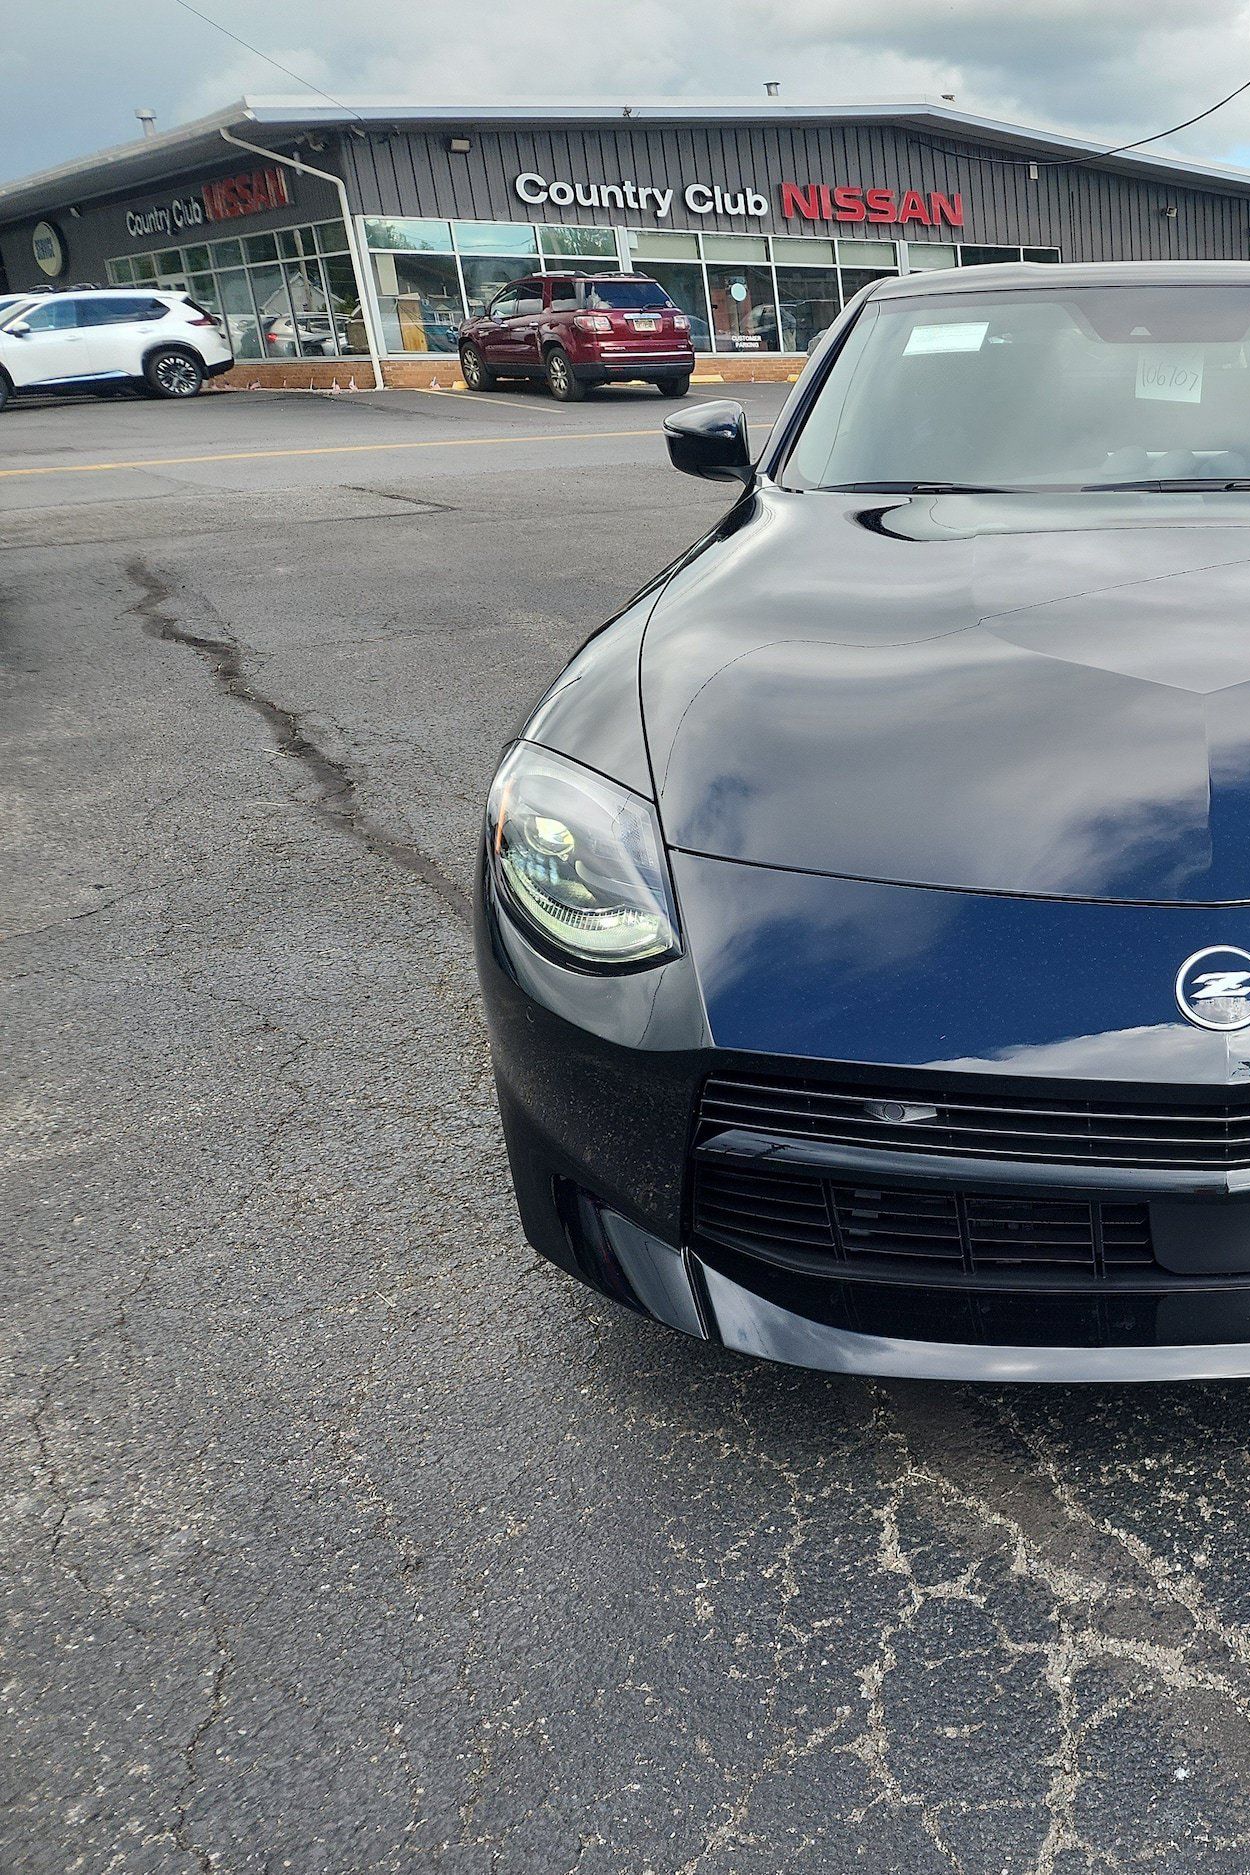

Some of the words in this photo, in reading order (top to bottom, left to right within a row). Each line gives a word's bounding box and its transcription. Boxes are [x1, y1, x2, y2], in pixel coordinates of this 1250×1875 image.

[126, 206, 172, 237] Country
[172, 197, 203, 227] Club
[202, 167, 289, 223] NISSAN
[515, 172, 673, 217] Country
[685, 183, 768, 216] Club
[781, 182, 964, 226] NISSAN
